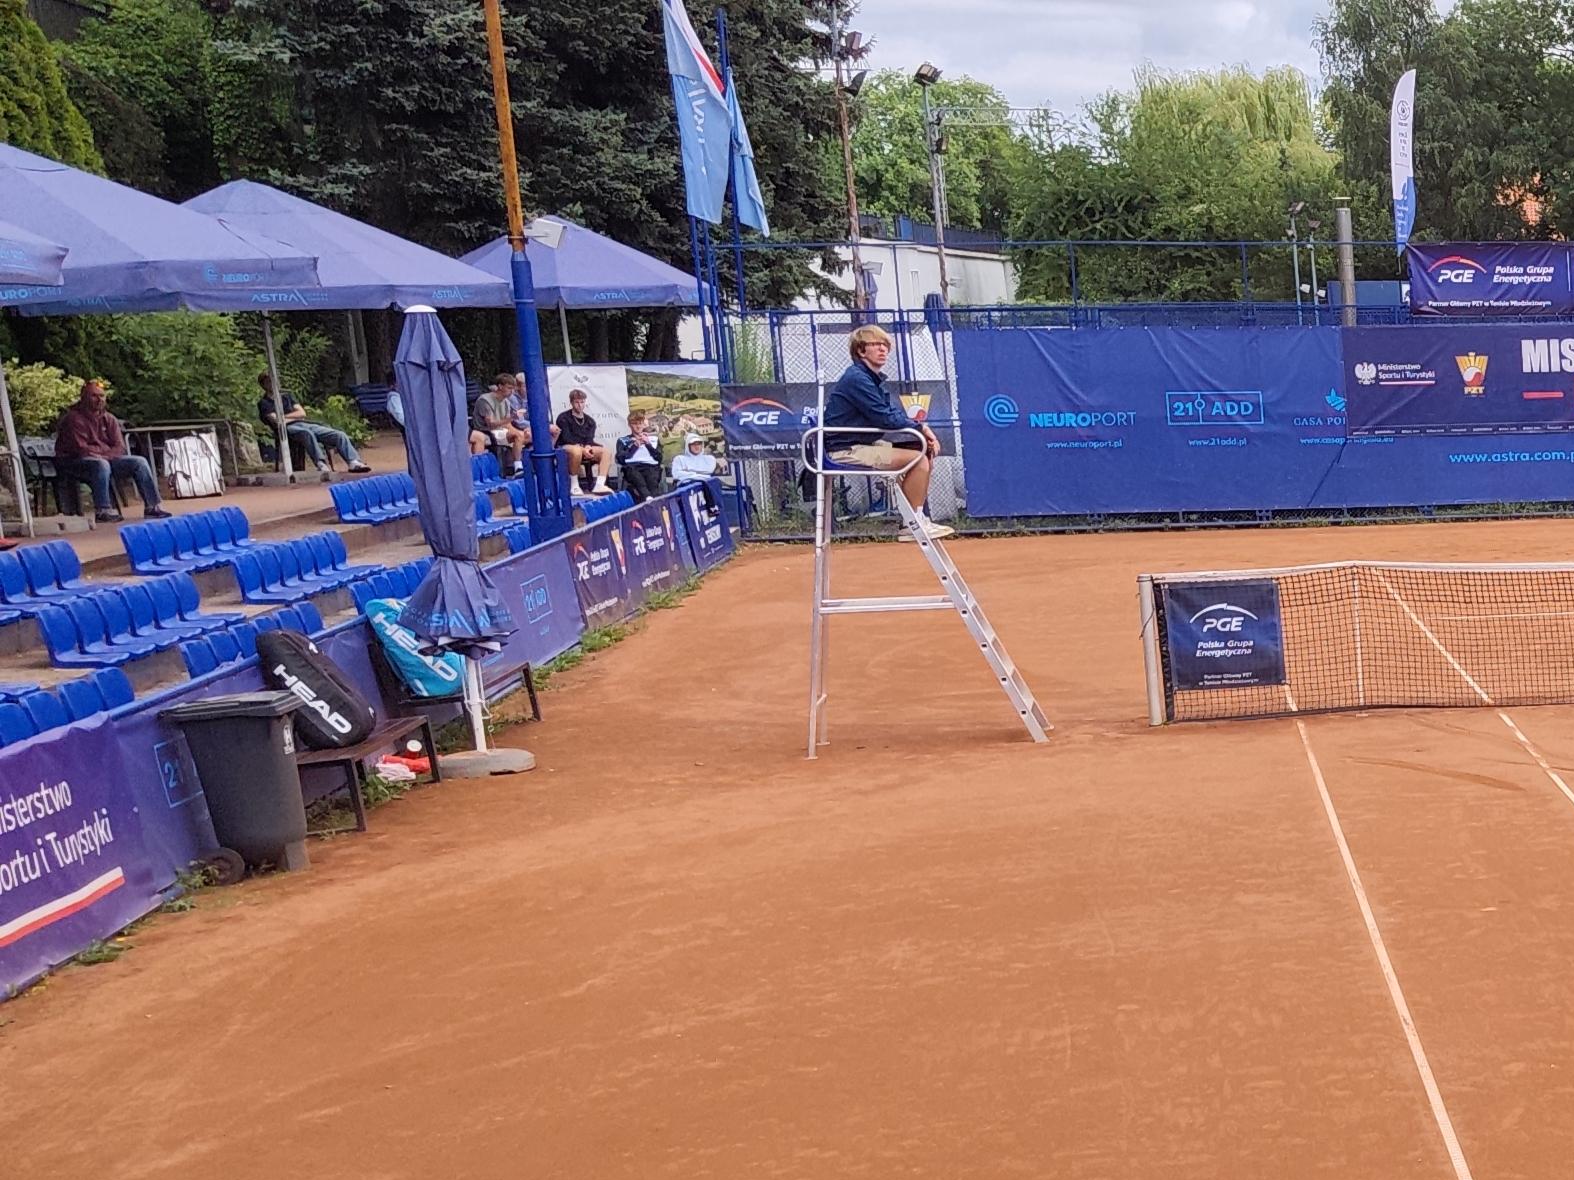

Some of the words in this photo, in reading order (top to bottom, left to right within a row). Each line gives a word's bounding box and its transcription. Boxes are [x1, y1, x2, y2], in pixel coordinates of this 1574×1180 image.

[1438, 269, 1475, 282] PGE
[1495, 266, 1523, 274] Polska
[1526, 266, 1554, 275] Grupa
[1493, 275, 1552, 284] Energetyczna
[1378, 363, 1421, 371] Ministerstwo
[1378, 371, 1400, 379] Sportu
[1405, 370, 1435, 379] Turystyki
[1211, 401, 1253, 416] ADD
[739, 411, 780, 425] PGE
[1028, 412, 1137, 428] NEUROPORT
[1294, 417, 1323, 426] CASA
[1046, 438, 1123, 449] www.neuroport.pl
[1188, 437, 1247, 447] www.21add.pl
[1202, 617, 1244, 632] PGE
[1197, 641, 1225, 649] Polska
[1227, 639, 1253, 648] Grupa
[1195, 648, 1252, 658] Energetyczna
[272, 663, 352, 734] HEAD
[0, 780, 72, 836] isterstwo
[0, 850, 41, 895] ortu
[37, 838, 51, 874] i
[45, 807, 114, 868] Turystyki
